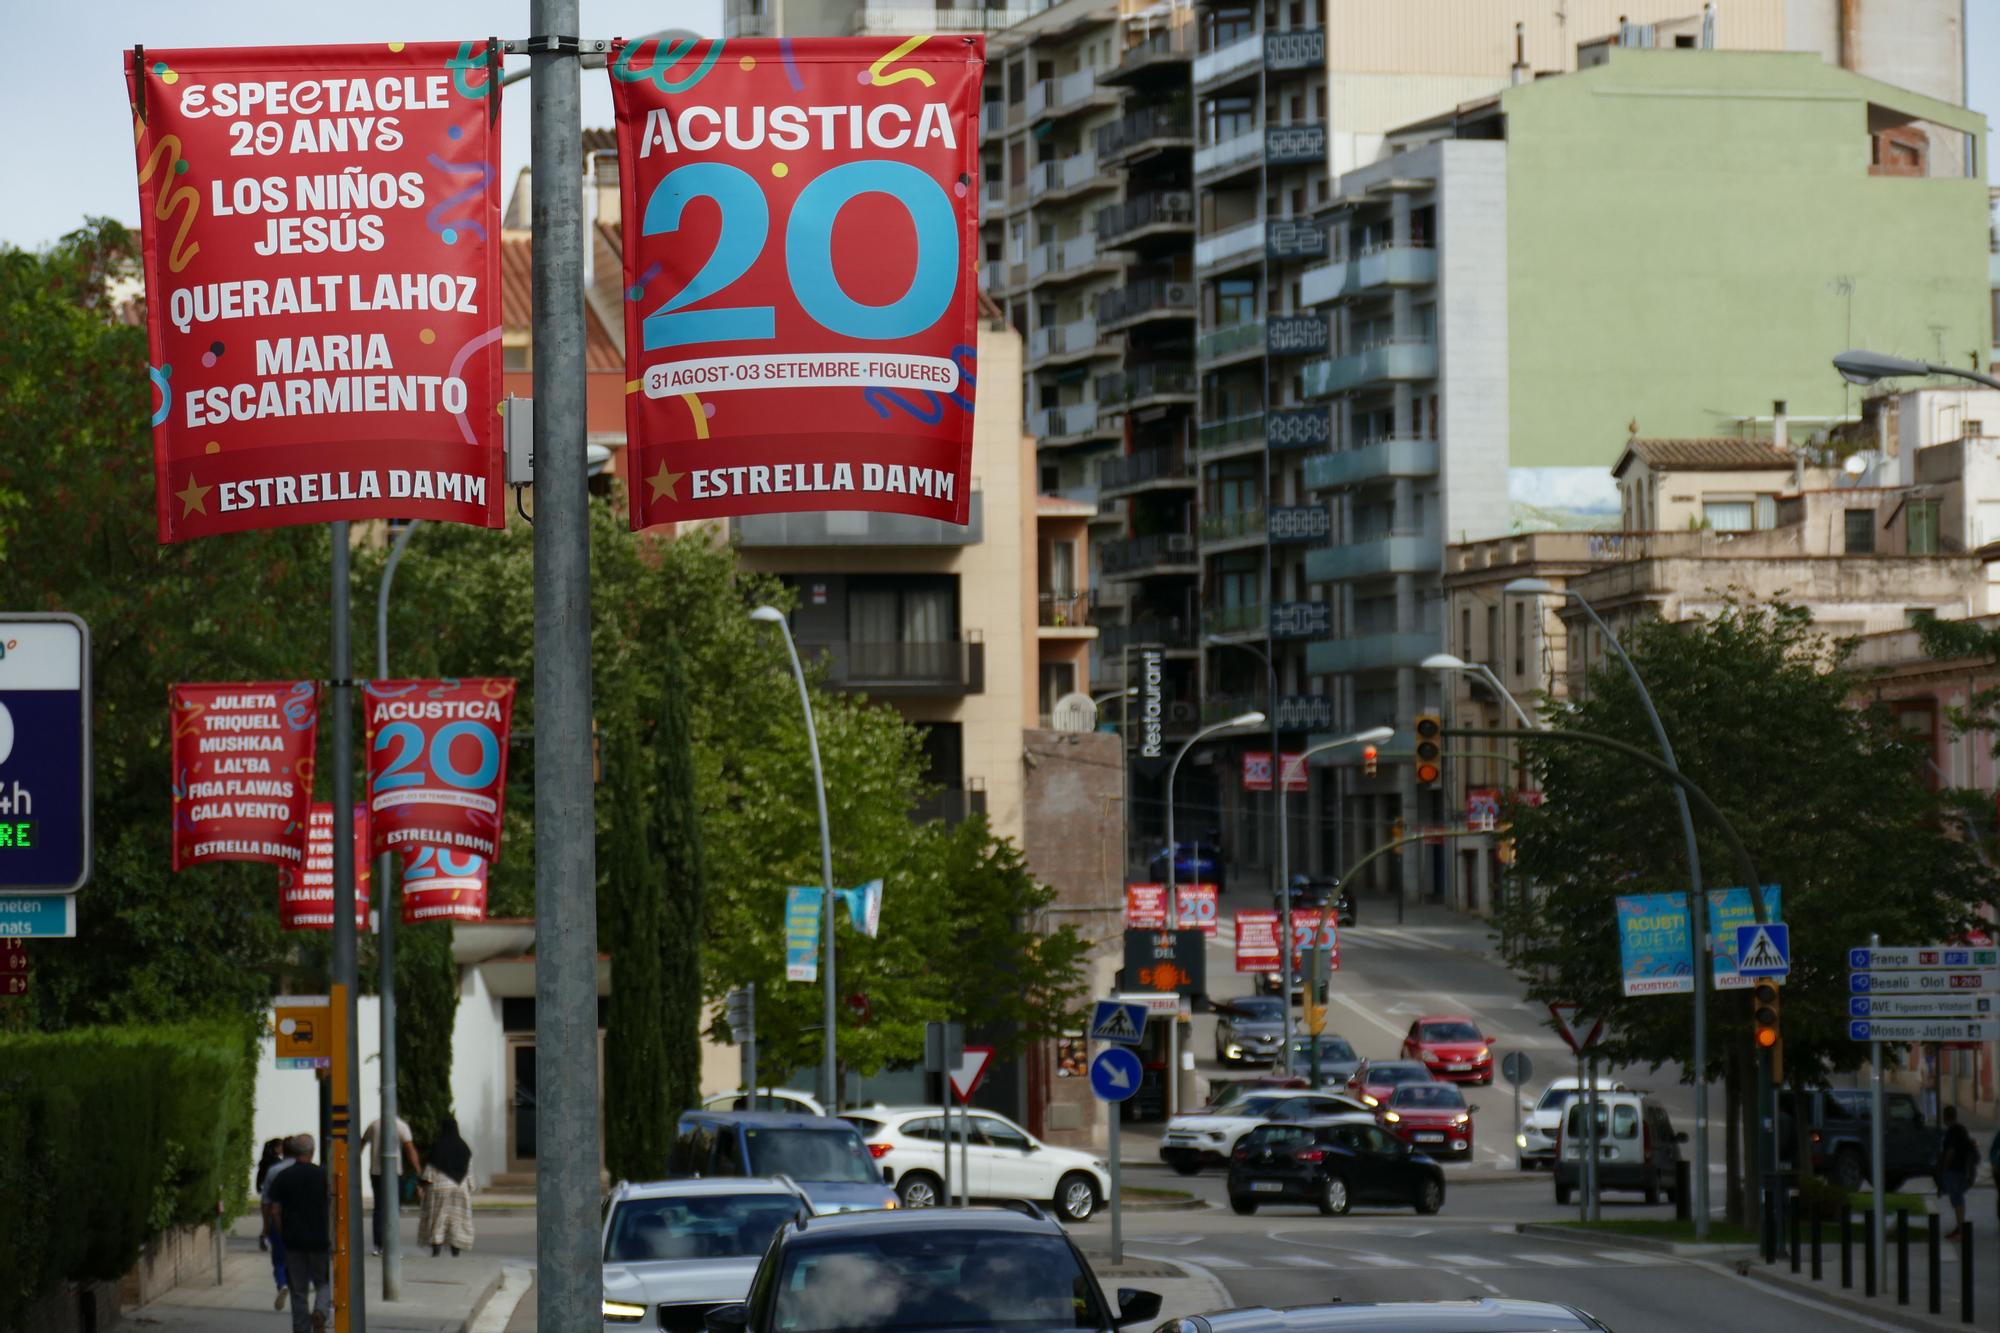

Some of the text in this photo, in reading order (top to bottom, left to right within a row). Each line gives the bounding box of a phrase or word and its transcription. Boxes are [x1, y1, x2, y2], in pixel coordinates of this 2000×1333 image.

[180, 75, 449, 118] ESPECTACLE
[229, 116, 404, 156] 20 ANYS
[639, 102, 957, 158] ACUSTICA
[211, 166, 425, 217] LOS NIÑOS
[254, 213, 384, 257] JESÚS
[642, 159, 960, 352] 20
[170, 273, 478, 334] QUERALT LAHOZ
[255, 333, 393, 376] MARIA
[651, 373, 668, 390] 31
[186, 376, 468, 429] ESCARMIENTO
[219, 469, 487, 513] ESTRELLA DAMM
[691, 462, 954, 502] ESTRELLA DAMM
[211, 694, 277, 710] JULIETA
[373, 700, 502, 723] ACUSTICA
[1142, 651, 1161, 758] Restaurant
[204, 714, 281, 732] TRIQUELL
[199, 735, 284, 753] MUSHKAA
[373, 720, 500, 794] 20
[189, 780, 293, 800] FIGA FLAWAS
[191, 803, 290, 821] CALA VENTO
[194, 840, 301, 862] ESTRELLA DAMM
[387, 828, 494, 854] ESTRELLA DAMM
[1180, 898, 1216, 922] 20
[1295, 927, 1337, 951] 20
[1154, 949, 1176, 959] DEL
[1870, 953, 1908, 966] França
[1872, 1001, 1890, 1011] AVE
[1871, 1025, 1914, 1037] Mossos
